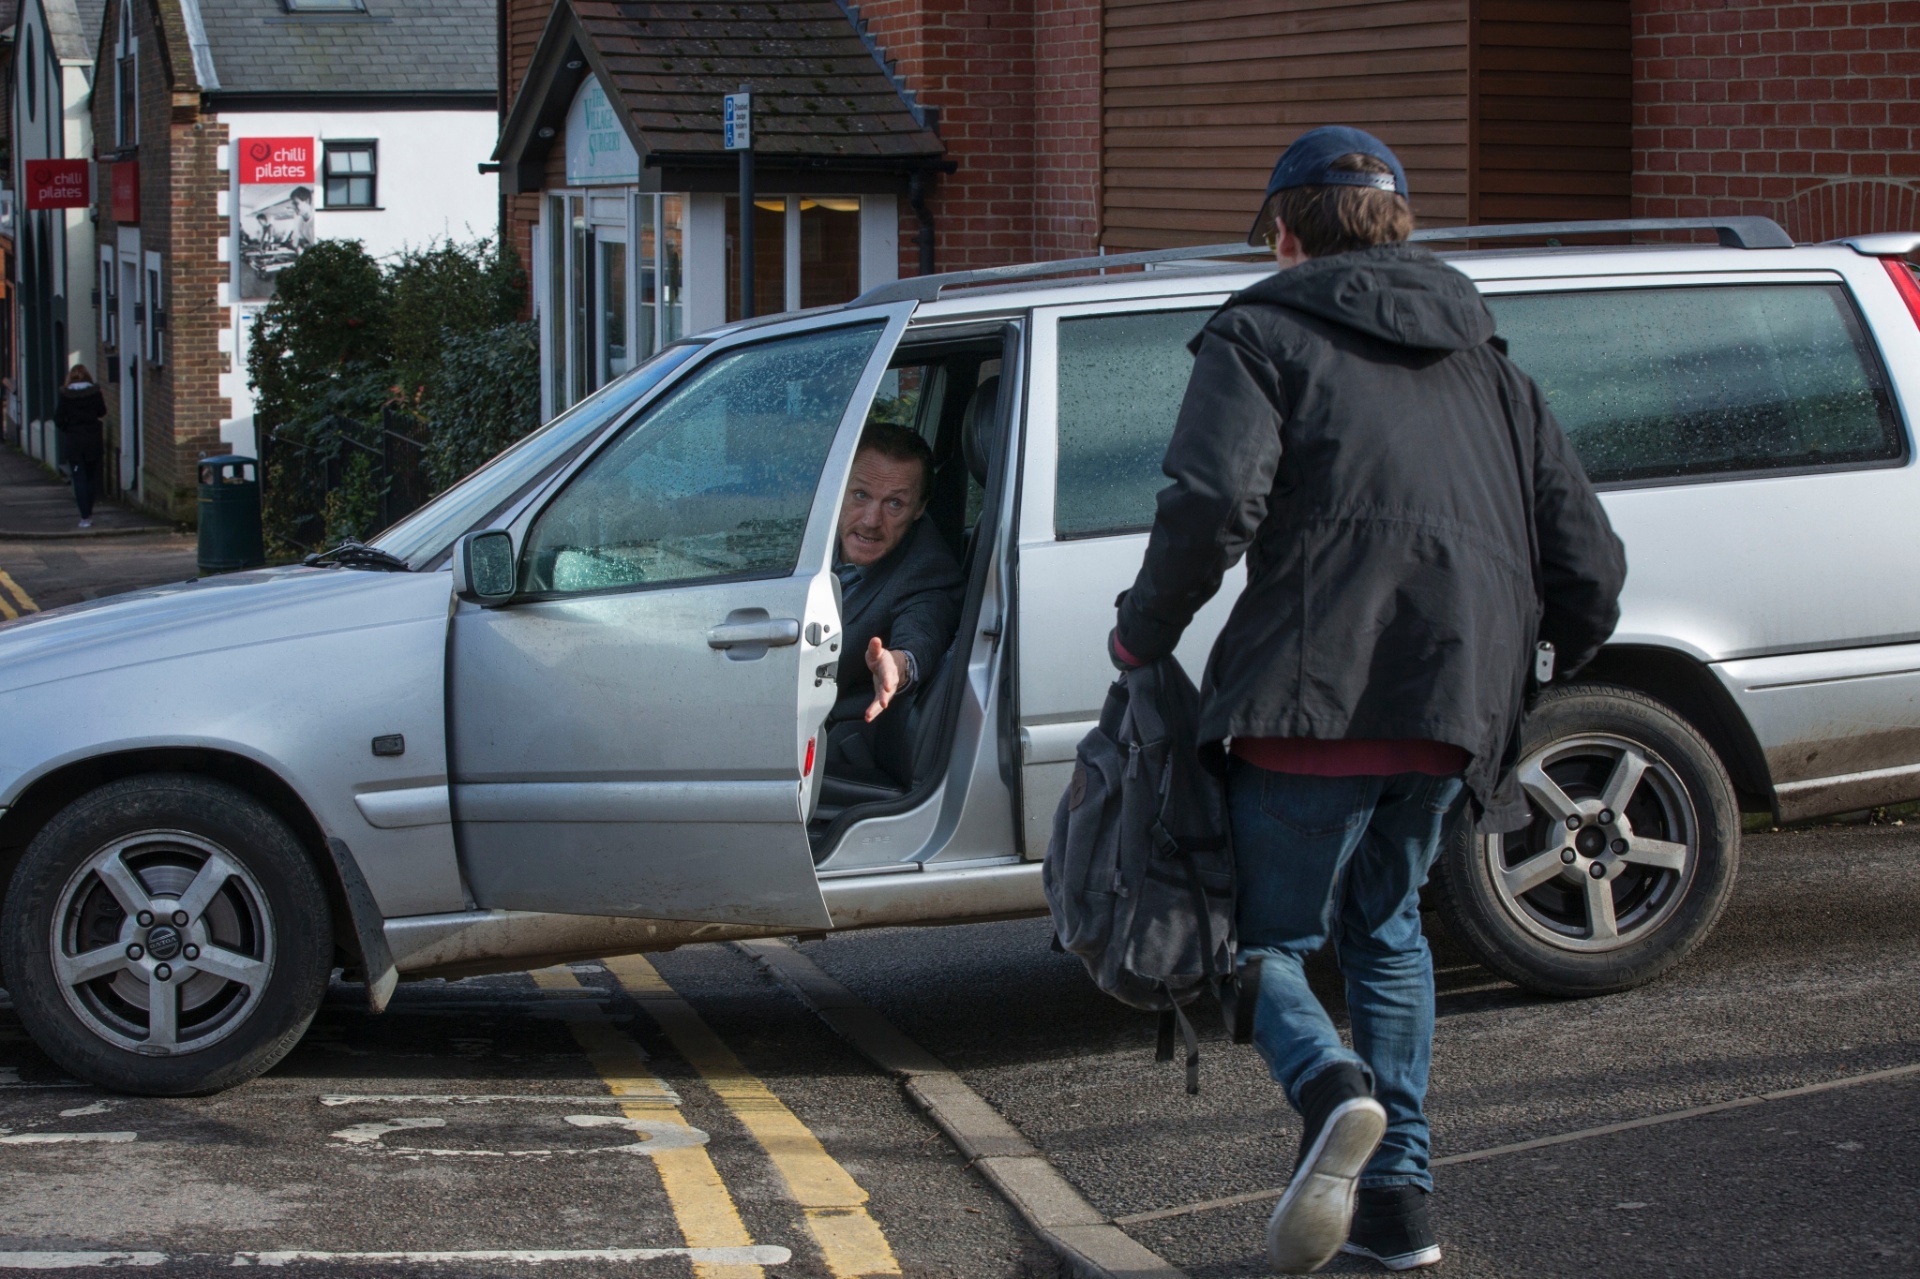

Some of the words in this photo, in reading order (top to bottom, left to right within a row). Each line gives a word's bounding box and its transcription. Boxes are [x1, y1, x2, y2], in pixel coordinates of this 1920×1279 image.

[591, 88, 604, 107] THE
[583, 98, 614, 130] VILLAGE
[727, 100, 732, 120] P
[273, 147, 306, 162] chilli
[589, 131, 620, 167] SURGERY
[54, 172, 82, 185] chilli
[255, 162, 306, 182] pilates
[38, 186, 82, 202] pilates
